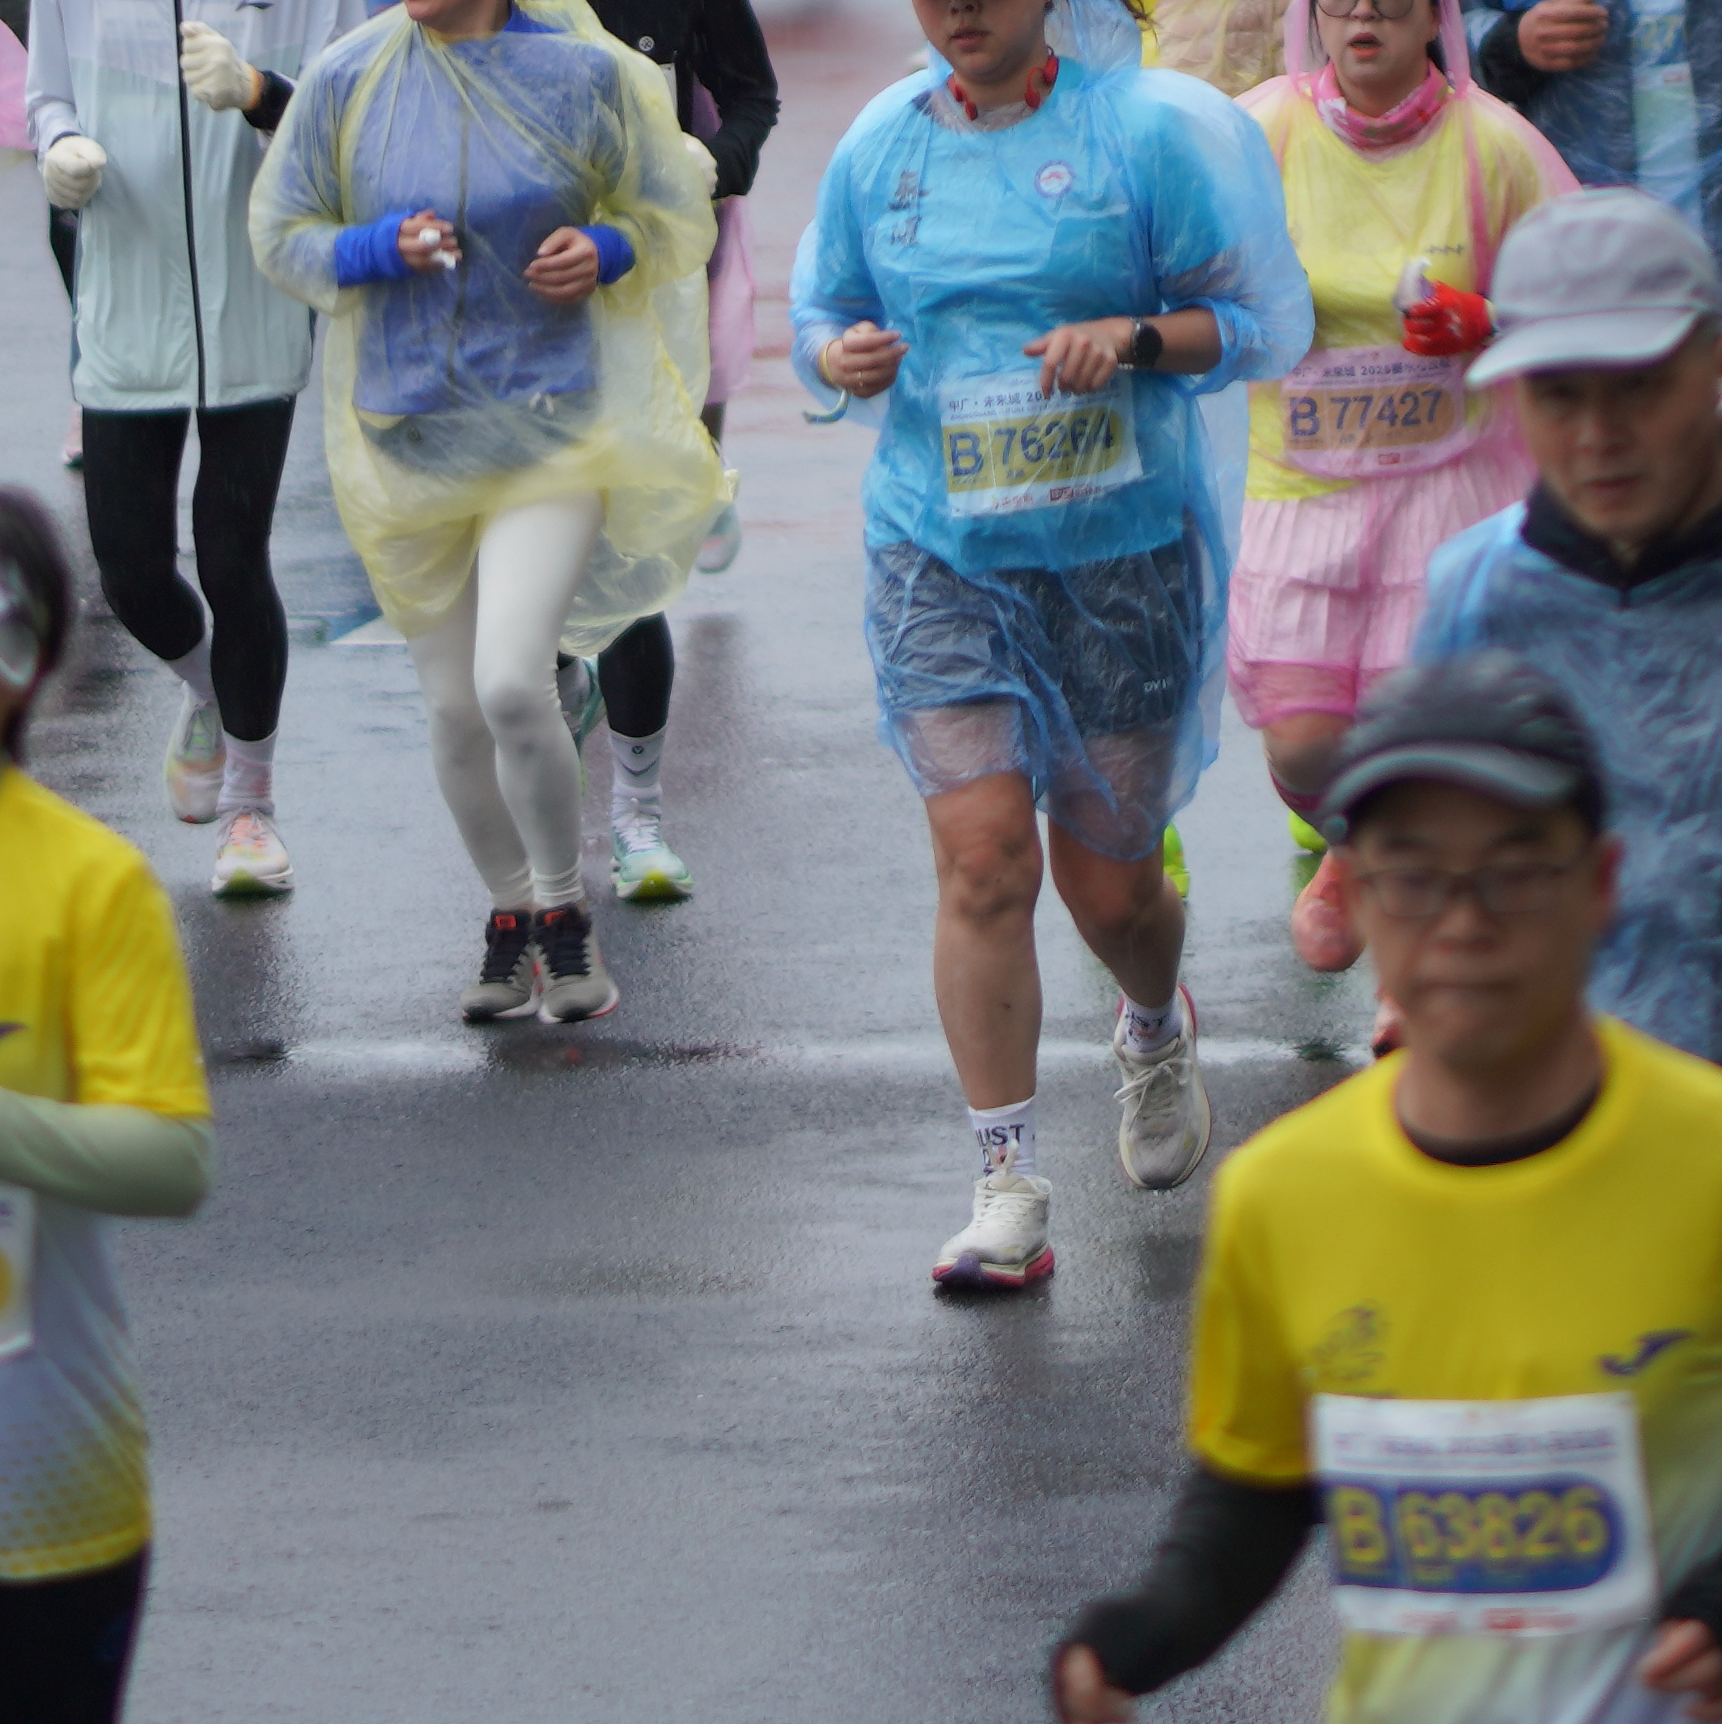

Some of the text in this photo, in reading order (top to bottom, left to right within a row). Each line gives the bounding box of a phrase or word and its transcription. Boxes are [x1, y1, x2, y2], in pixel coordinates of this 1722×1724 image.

[1290, 389, 1443, 436] B 77427
[949, 431, 984, 476] B
[975, 1123, 1025, 1146] UST
[1333, 1485, 1609, 1564] B 63826
